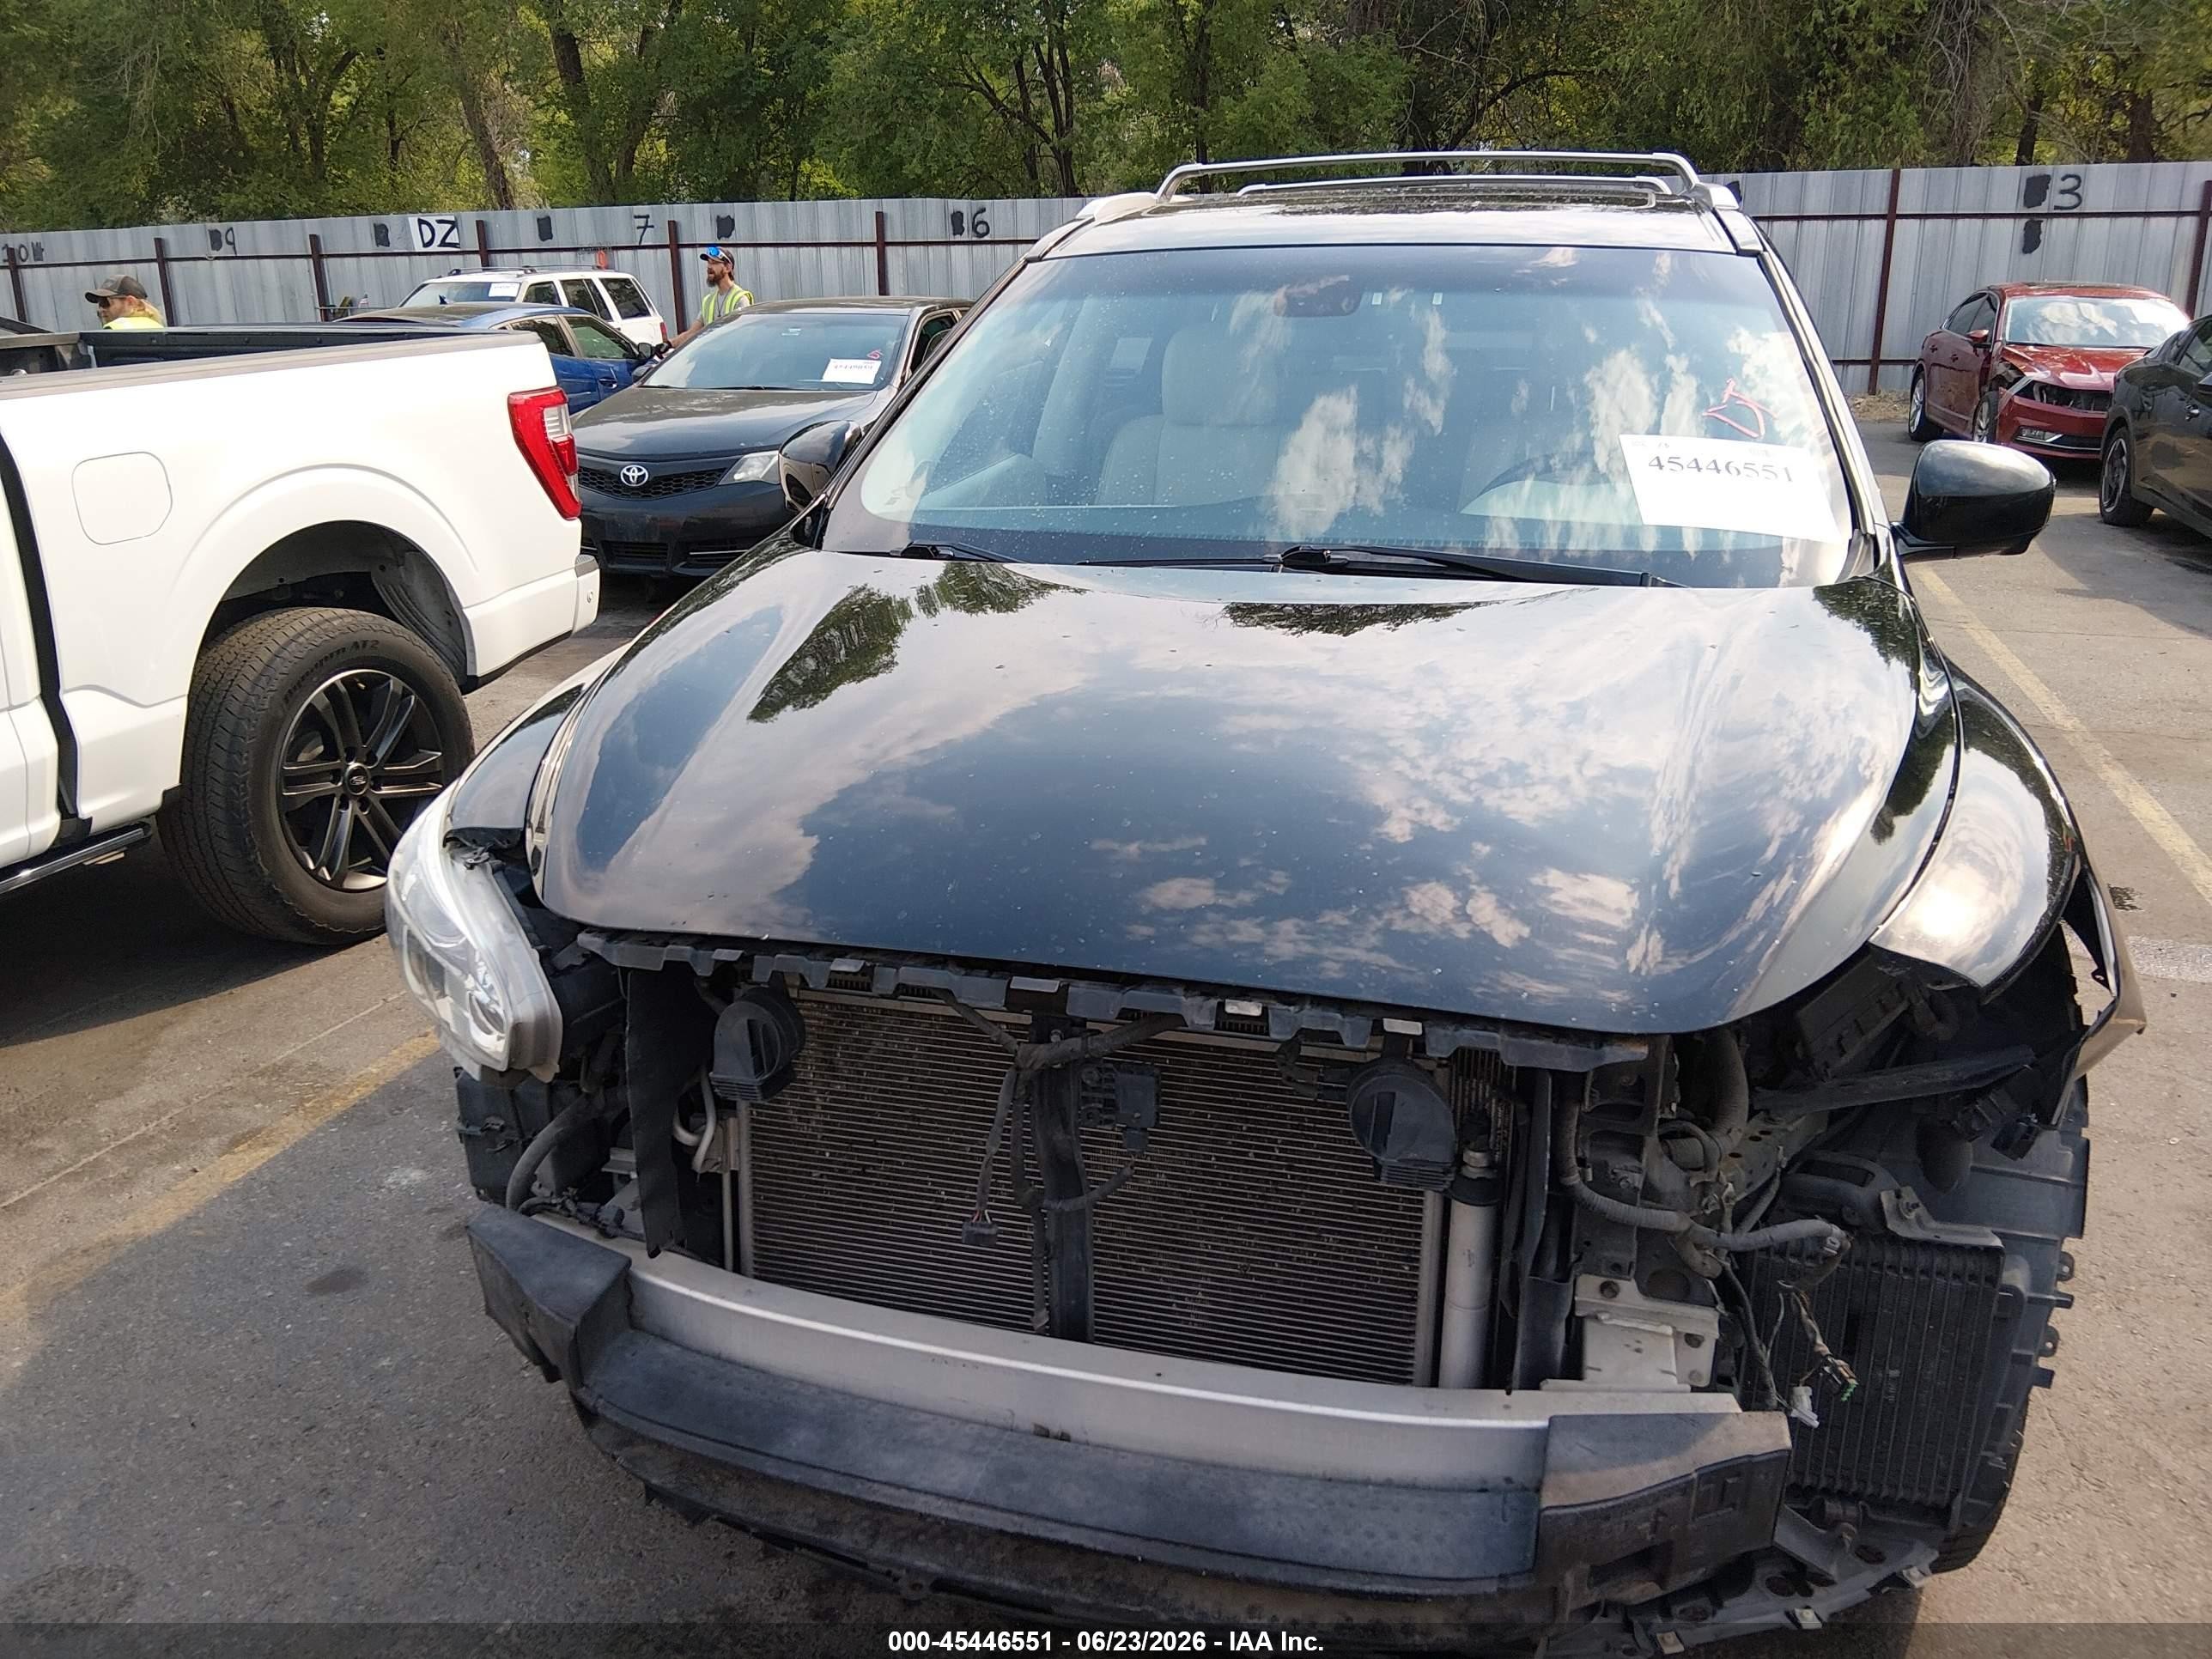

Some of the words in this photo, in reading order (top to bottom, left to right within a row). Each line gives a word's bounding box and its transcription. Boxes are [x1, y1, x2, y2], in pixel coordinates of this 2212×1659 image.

[2053, 173, 2082, 210] 3
[633, 214, 654, 246] 7
[971, 207, 990, 238] 6
[225, 226, 238, 257] 9
[1648, 455, 1793, 483] 45446551
